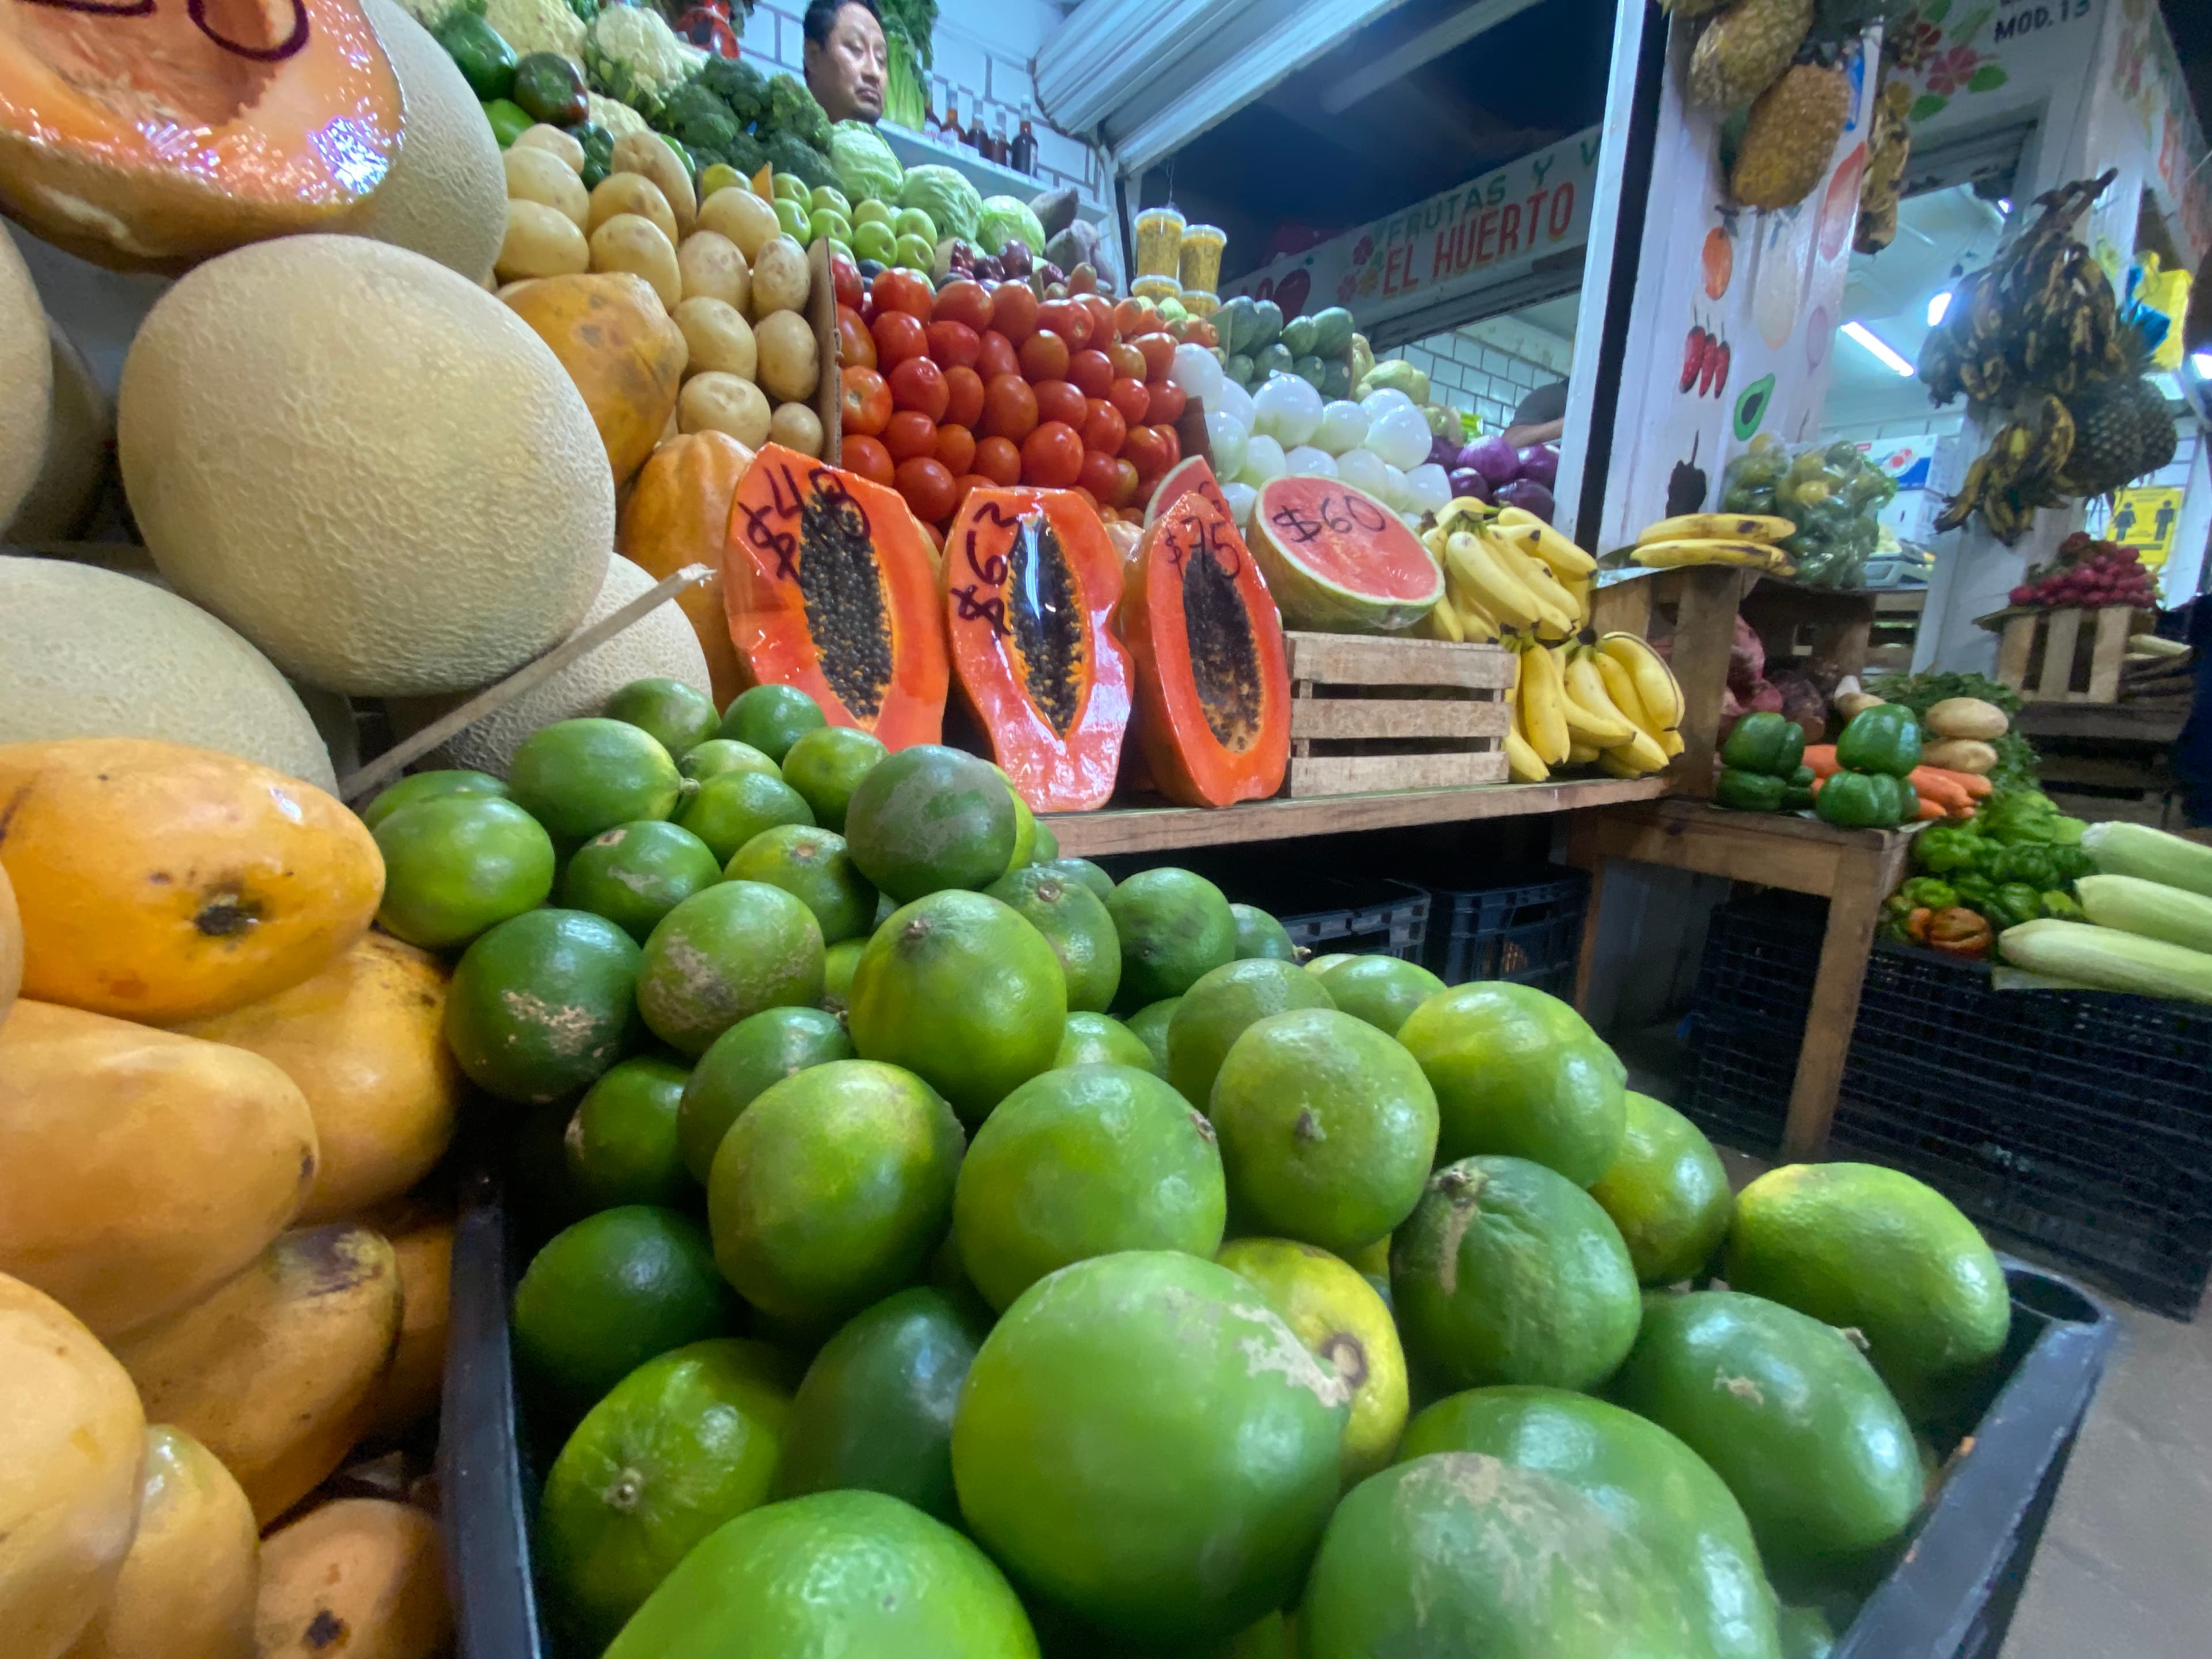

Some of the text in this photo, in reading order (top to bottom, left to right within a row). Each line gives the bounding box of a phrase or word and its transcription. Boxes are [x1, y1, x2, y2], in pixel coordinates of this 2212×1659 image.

[1994, 6, 2054, 43] MOD.
[1386, 174, 1506, 247] FRUTAS
[1532, 153, 1554, 188] Y
[1383, 181, 1574, 296] EL HUERTO
[1165, 516, 1241, 583] $75
[1272, 495, 1387, 543] $60
